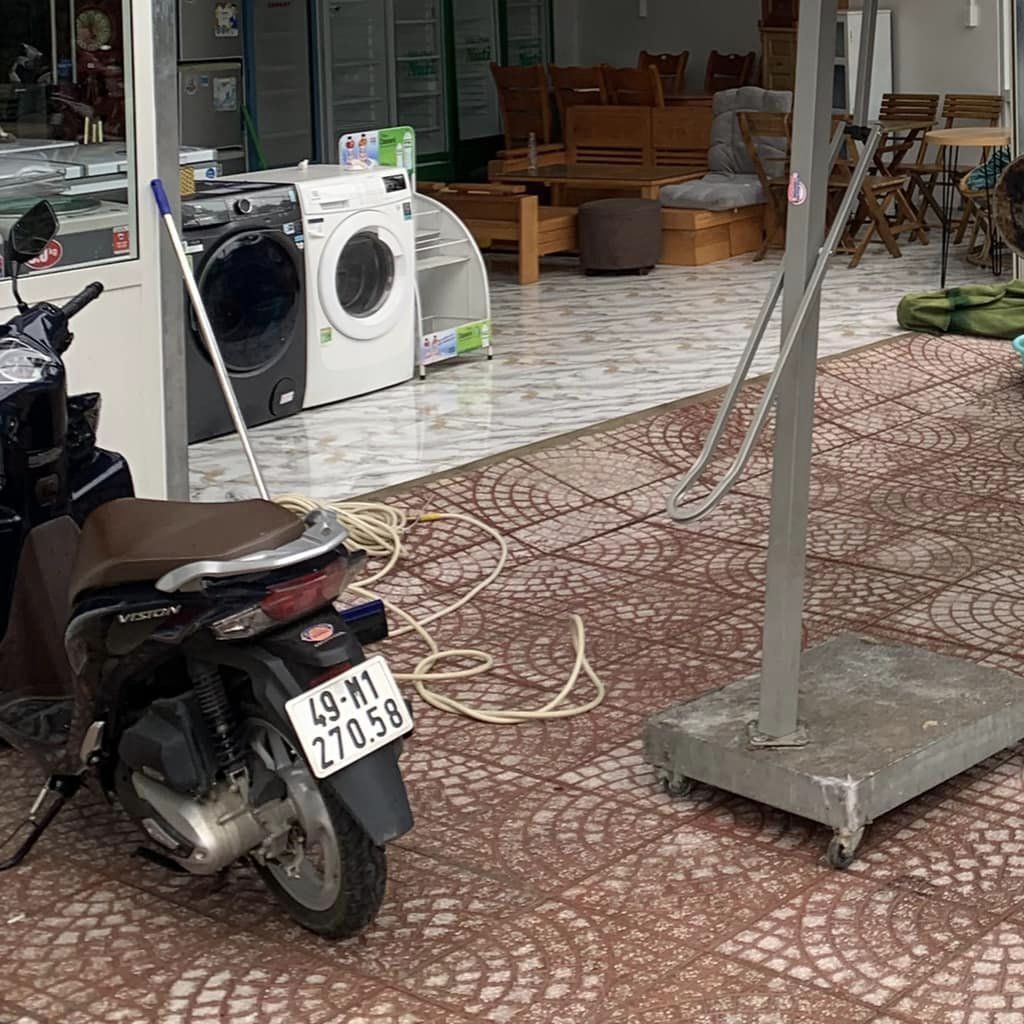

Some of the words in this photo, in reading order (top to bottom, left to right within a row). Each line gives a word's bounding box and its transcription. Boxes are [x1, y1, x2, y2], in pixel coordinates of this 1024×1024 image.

[117, 604, 181, 624] VISION
[309, 670, 379, 727] 49-M1
[312, 698, 403, 770] 270.58
